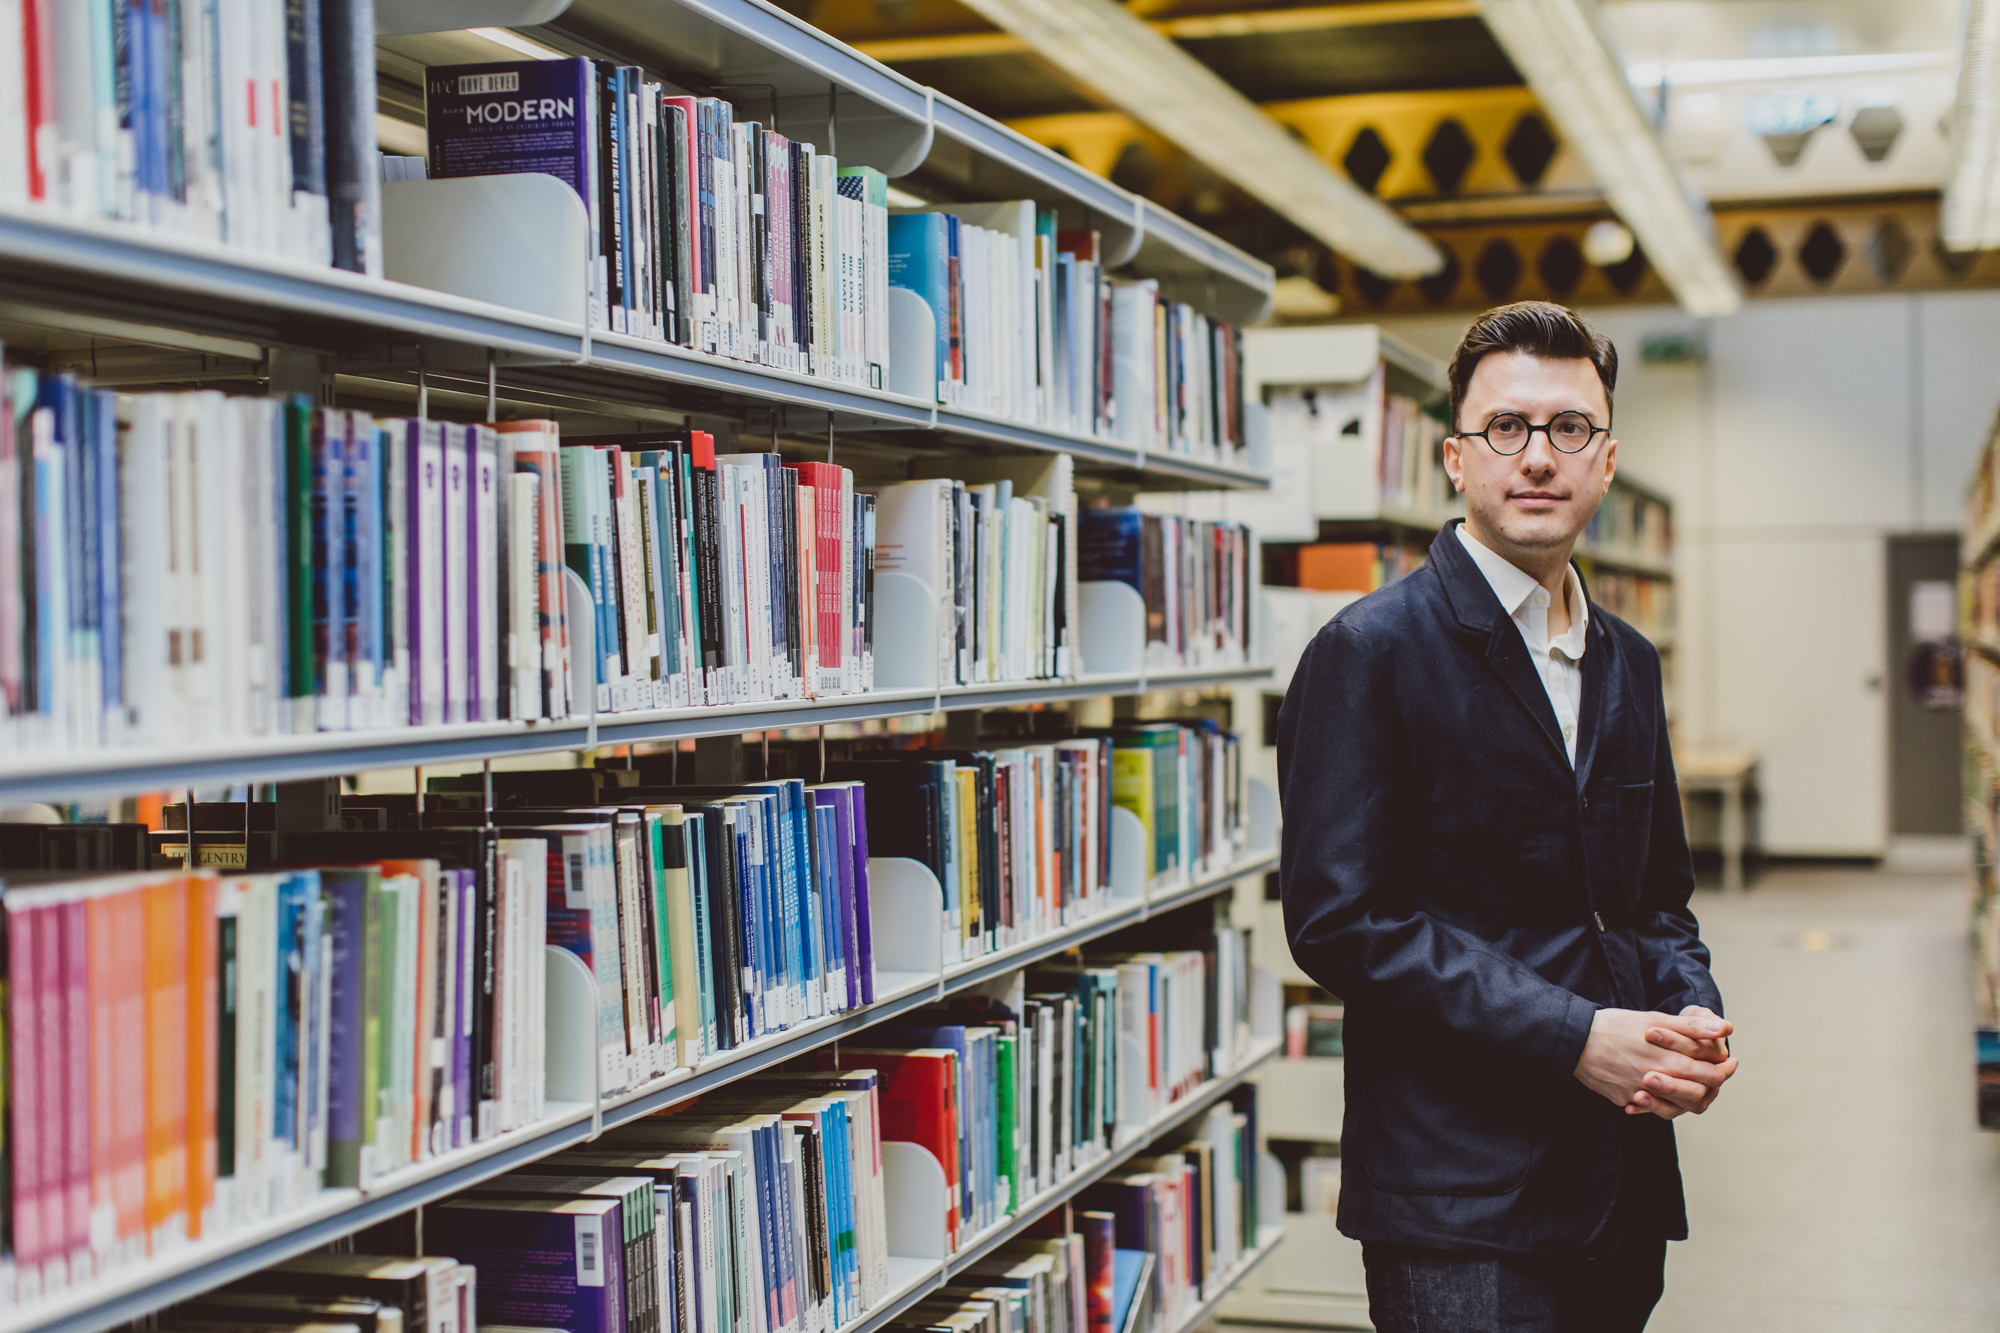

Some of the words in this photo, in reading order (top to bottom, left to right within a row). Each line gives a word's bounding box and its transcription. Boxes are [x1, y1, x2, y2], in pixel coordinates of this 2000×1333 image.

[461, 76, 484, 92] HAVE
[489, 74, 516, 90] NEVER
[466, 97, 574, 124] MODERN
[611, 142, 620, 190] POLITICAL
[198, 852, 245, 864] GENTRY
[703, 1222, 706, 1233] AS
[708, 1220, 712, 1230] AS
[765, 1180, 776, 1274] SOCIOLOGY
[776, 1177, 786, 1269] SOCIOLOGY
[782, 1170, 793, 1263] SOCIOLOGY
